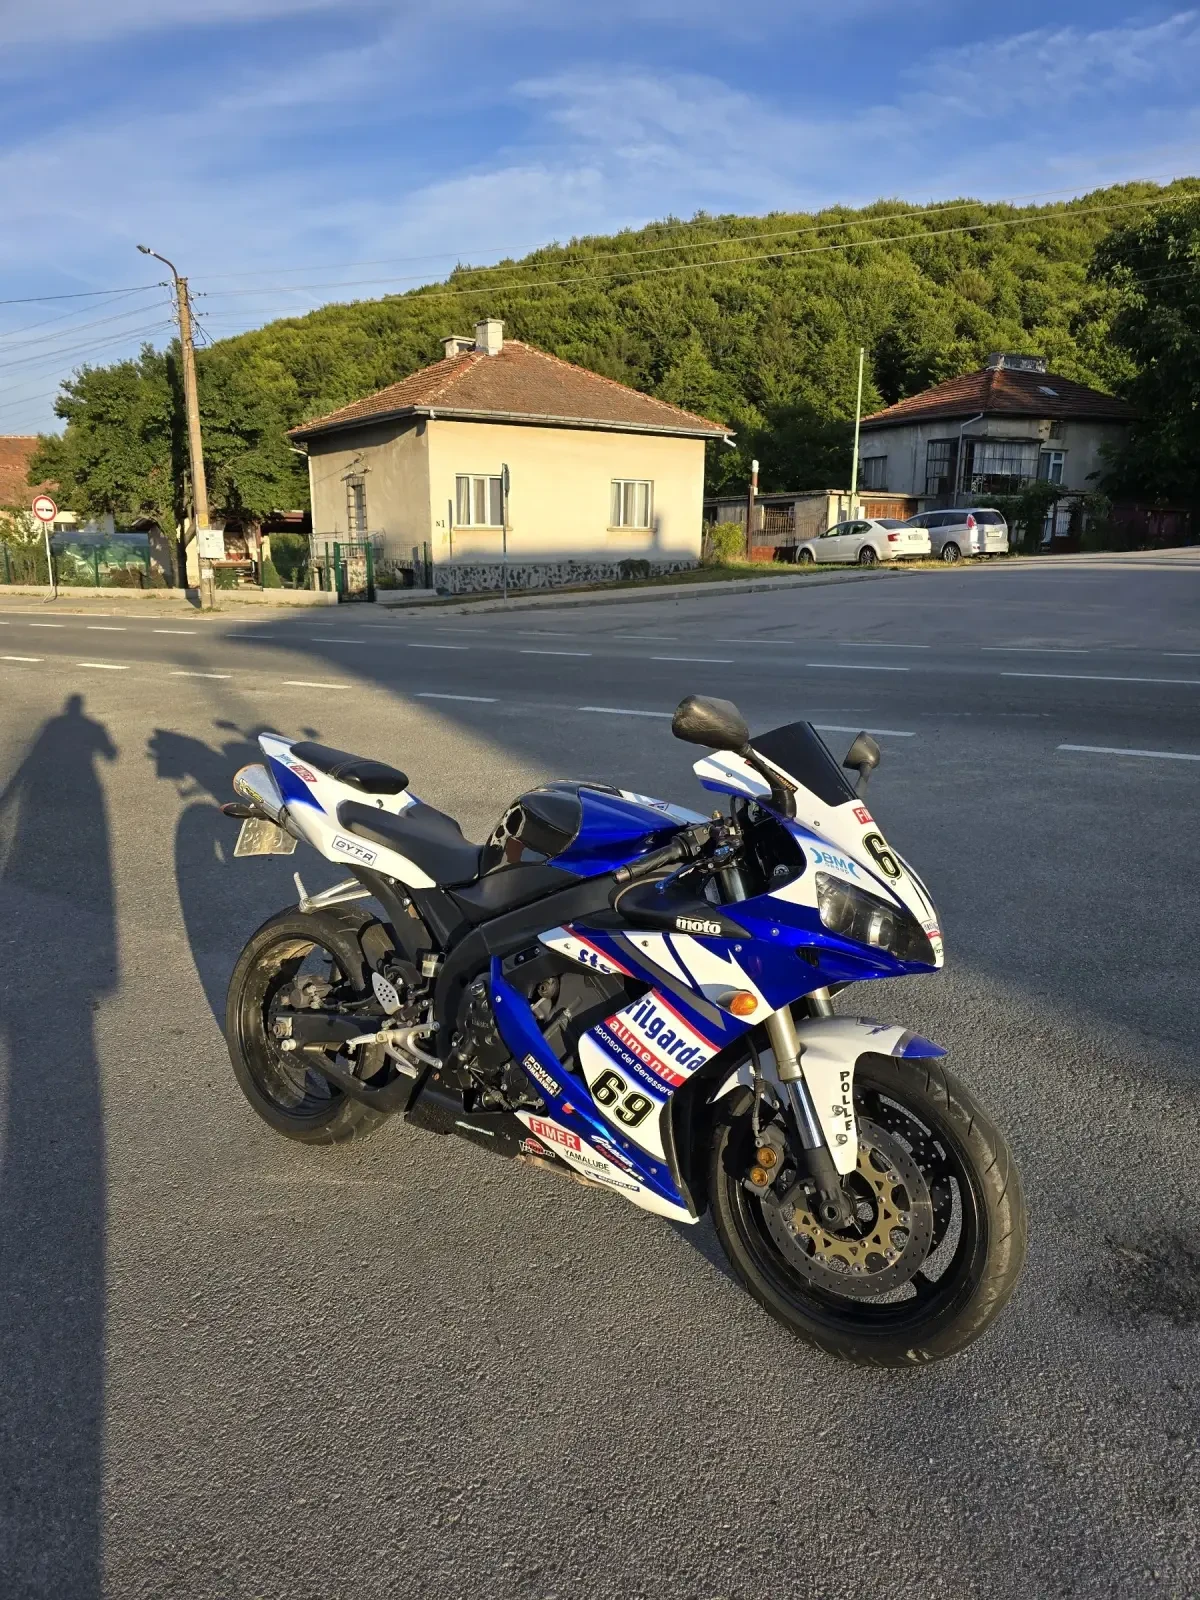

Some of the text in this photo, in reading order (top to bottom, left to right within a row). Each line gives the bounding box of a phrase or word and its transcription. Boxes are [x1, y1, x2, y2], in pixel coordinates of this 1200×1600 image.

[675, 917, 721, 934] moto
[593, 1024, 674, 1096] sponsor del Benessere
[609, 1019, 677, 1082] alimenti
[528, 1055, 559, 1089] POWER
[589, 1068, 655, 1128] 69
[532, 1121, 577, 1149] FIMER
[564, 1148, 610, 1170] YAMALUBE
